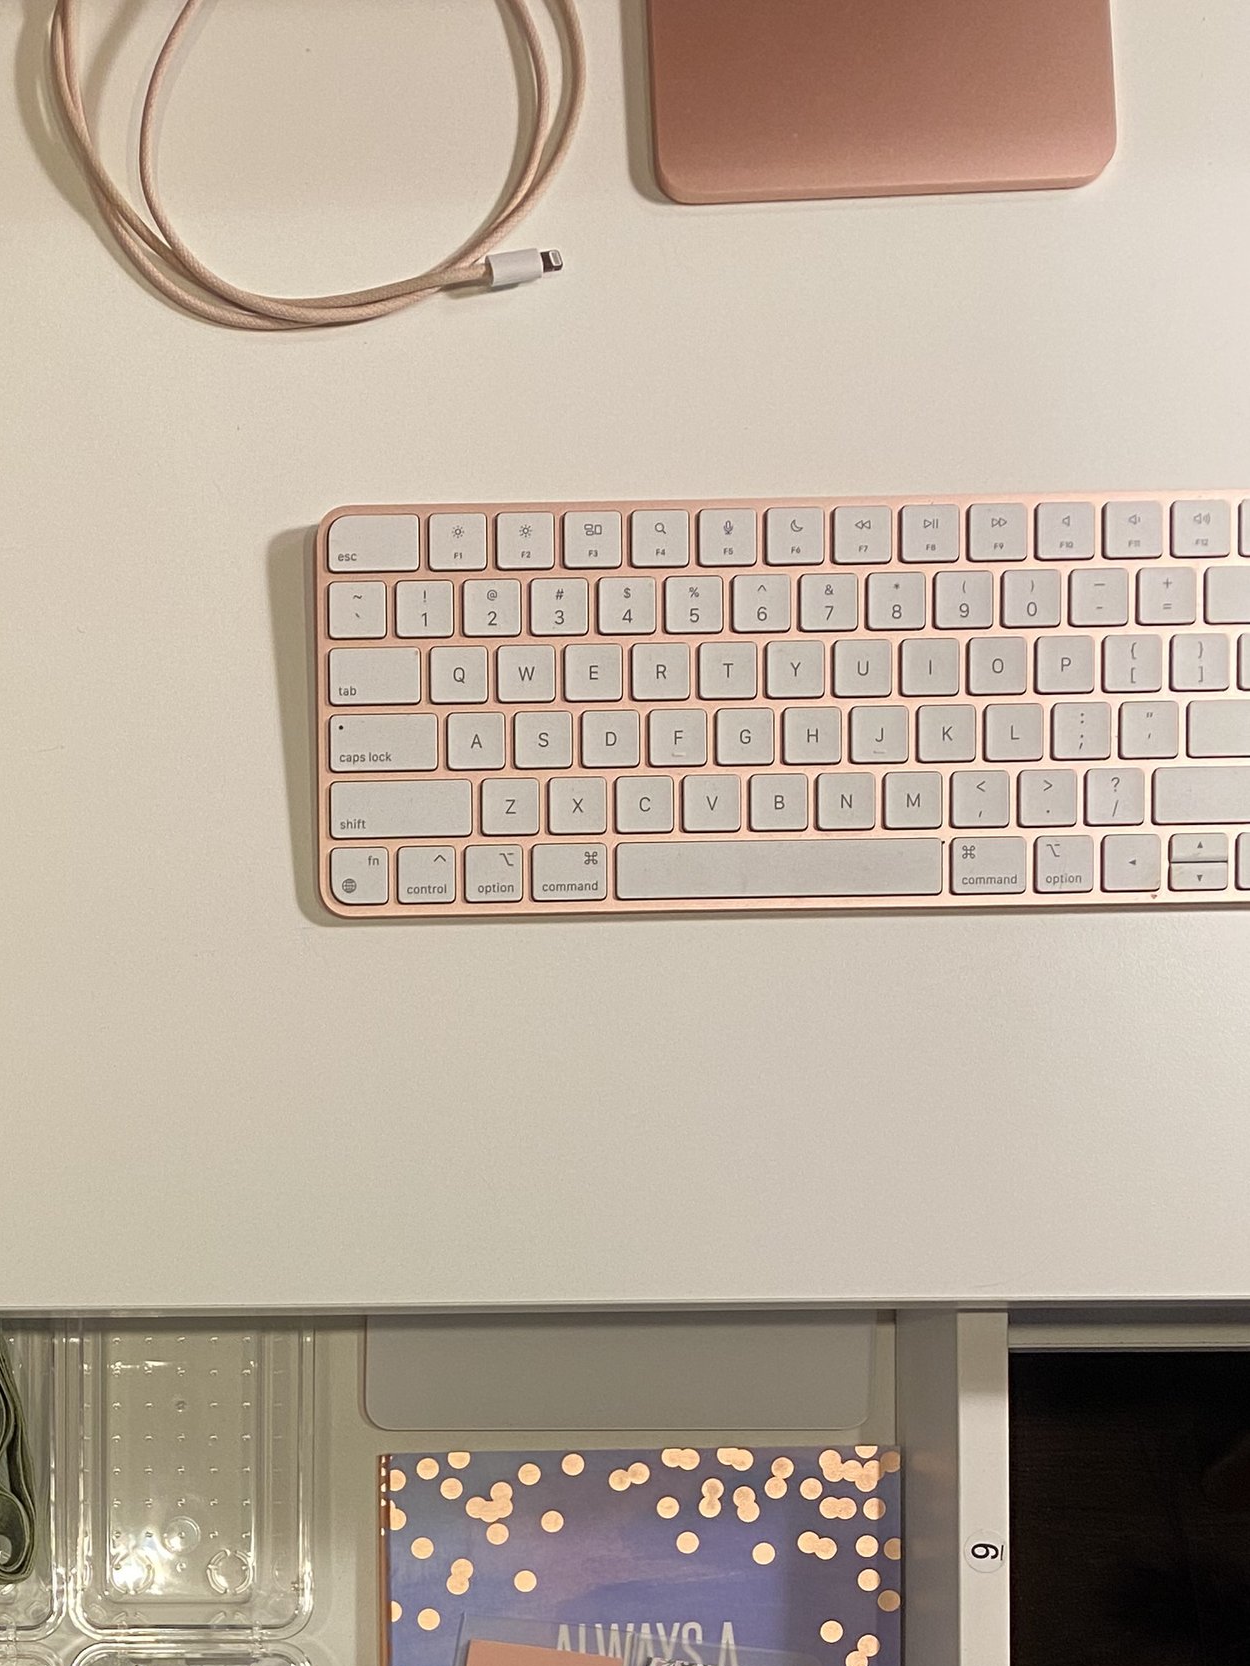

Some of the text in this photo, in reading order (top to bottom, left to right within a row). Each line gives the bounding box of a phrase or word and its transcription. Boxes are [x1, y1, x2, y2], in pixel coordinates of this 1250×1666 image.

[790, 546, 801, 554] F6
[858, 544, 869, 553] F7
[925, 543, 936, 551] F8
[993, 542, 1004, 550] F9
[1059, 540, 1074, 549] F10
[1127, 539, 1141, 548] F11
[1194, 538, 1209, 547] F12
[337, 553, 357, 562] esc
[453, 552, 463, 560] F1
[520, 550, 531, 559] F2
[588, 549, 599, 558] F3
[655, 548, 666, 556] F4
[723, 547, 734, 556] F5
[486, 589, 498, 602] @
[555, 588, 564, 600] #
[623, 587, 632, 599] $
[688, 586, 700, 598] %
[824, 584, 834, 596] &
[621, 608, 633, 624] 4
[689, 607, 700, 624] 5
[756, 606, 768, 622] 6
[824, 605, 834, 621] 7
[891, 604, 902, 620] 8
[959, 602, 970, 619] 9
[1026, 601, 1038, 617] 0
[421, 612, 428, 627] 1
[487, 610, 498, 626] 2
[554, 609, 565, 626] 3
[656, 663, 667, 680] R
[722, 662, 734, 679] T
[790, 661, 801, 677] Y
[857, 660, 870, 677] U
[991, 658, 1004, 674] O
[1060, 656, 1072, 672] P
[453, 666, 465, 684] Q
[518, 666, 535, 682] W
[589, 664, 599, 681] E
[338, 686, 357, 697] tab
[538, 732, 549, 748] S
[605, 731, 617, 747] D
[674, 730, 684, 745] F
[739, 729, 752, 745] G
[806, 728, 819, 743] H
[874, 727, 884, 743] J
[942, 726, 953, 742] K
[1010, 725, 1020, 741] L
[470, 733, 483, 749] A
[339, 751, 392, 765] caps lock
[976, 780, 986, 793] <
[1043, 779, 1053, 792] >
[1111, 776, 1120, 793] ?
[505, 799, 517, 815] Z
[572, 798, 584, 814] X
[639, 796, 651, 813] C
[706, 795, 719, 811] V
[774, 794, 786, 810] B
[840, 793, 853, 809] N
[906, 793, 921, 808] M
[340, 818, 366, 830] shift
[367, 855, 380, 866] fn
[542, 880, 599, 892] command
[961, 874, 1018, 886] command
[1045, 874, 1082, 886] option
[406, 883, 447, 895] control
[477, 882, 515, 895] option
